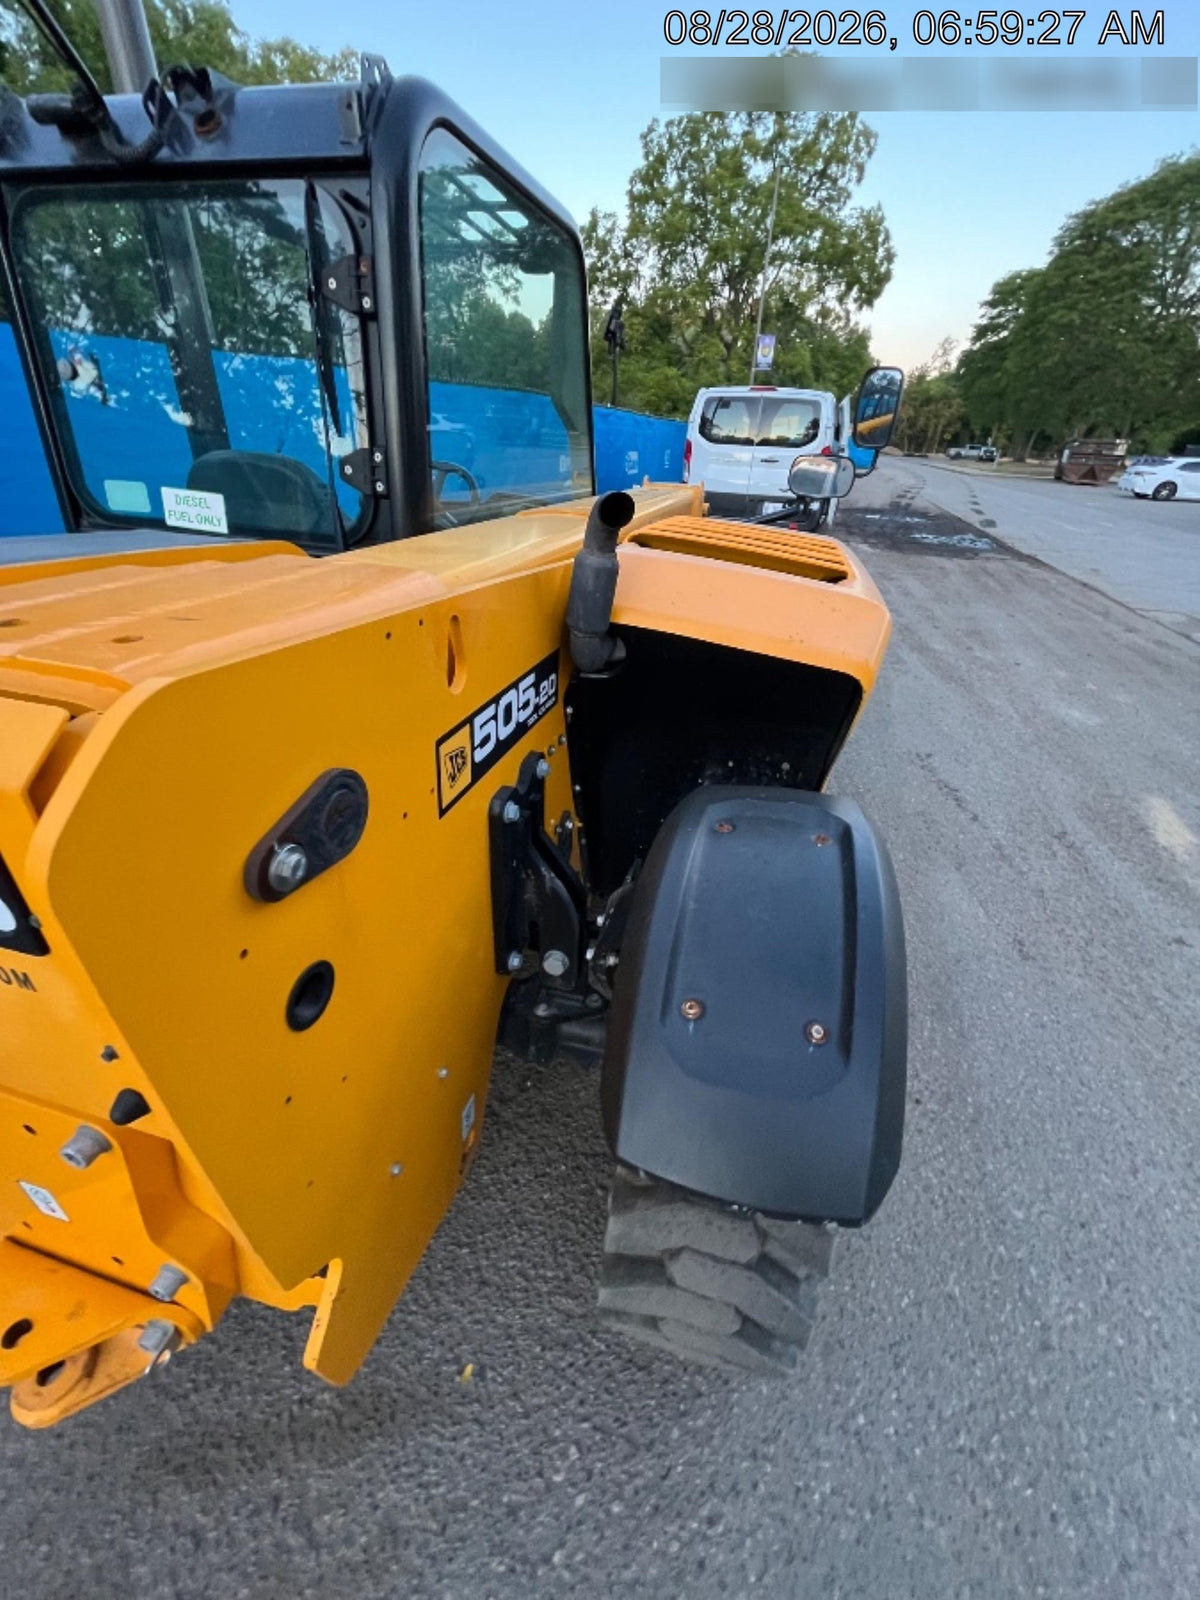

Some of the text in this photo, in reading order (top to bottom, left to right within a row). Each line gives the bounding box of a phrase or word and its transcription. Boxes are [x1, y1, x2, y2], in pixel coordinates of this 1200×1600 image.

[175, 494, 211, 509] DIESEL
[168, 510, 222, 527] FUEL ONLY
